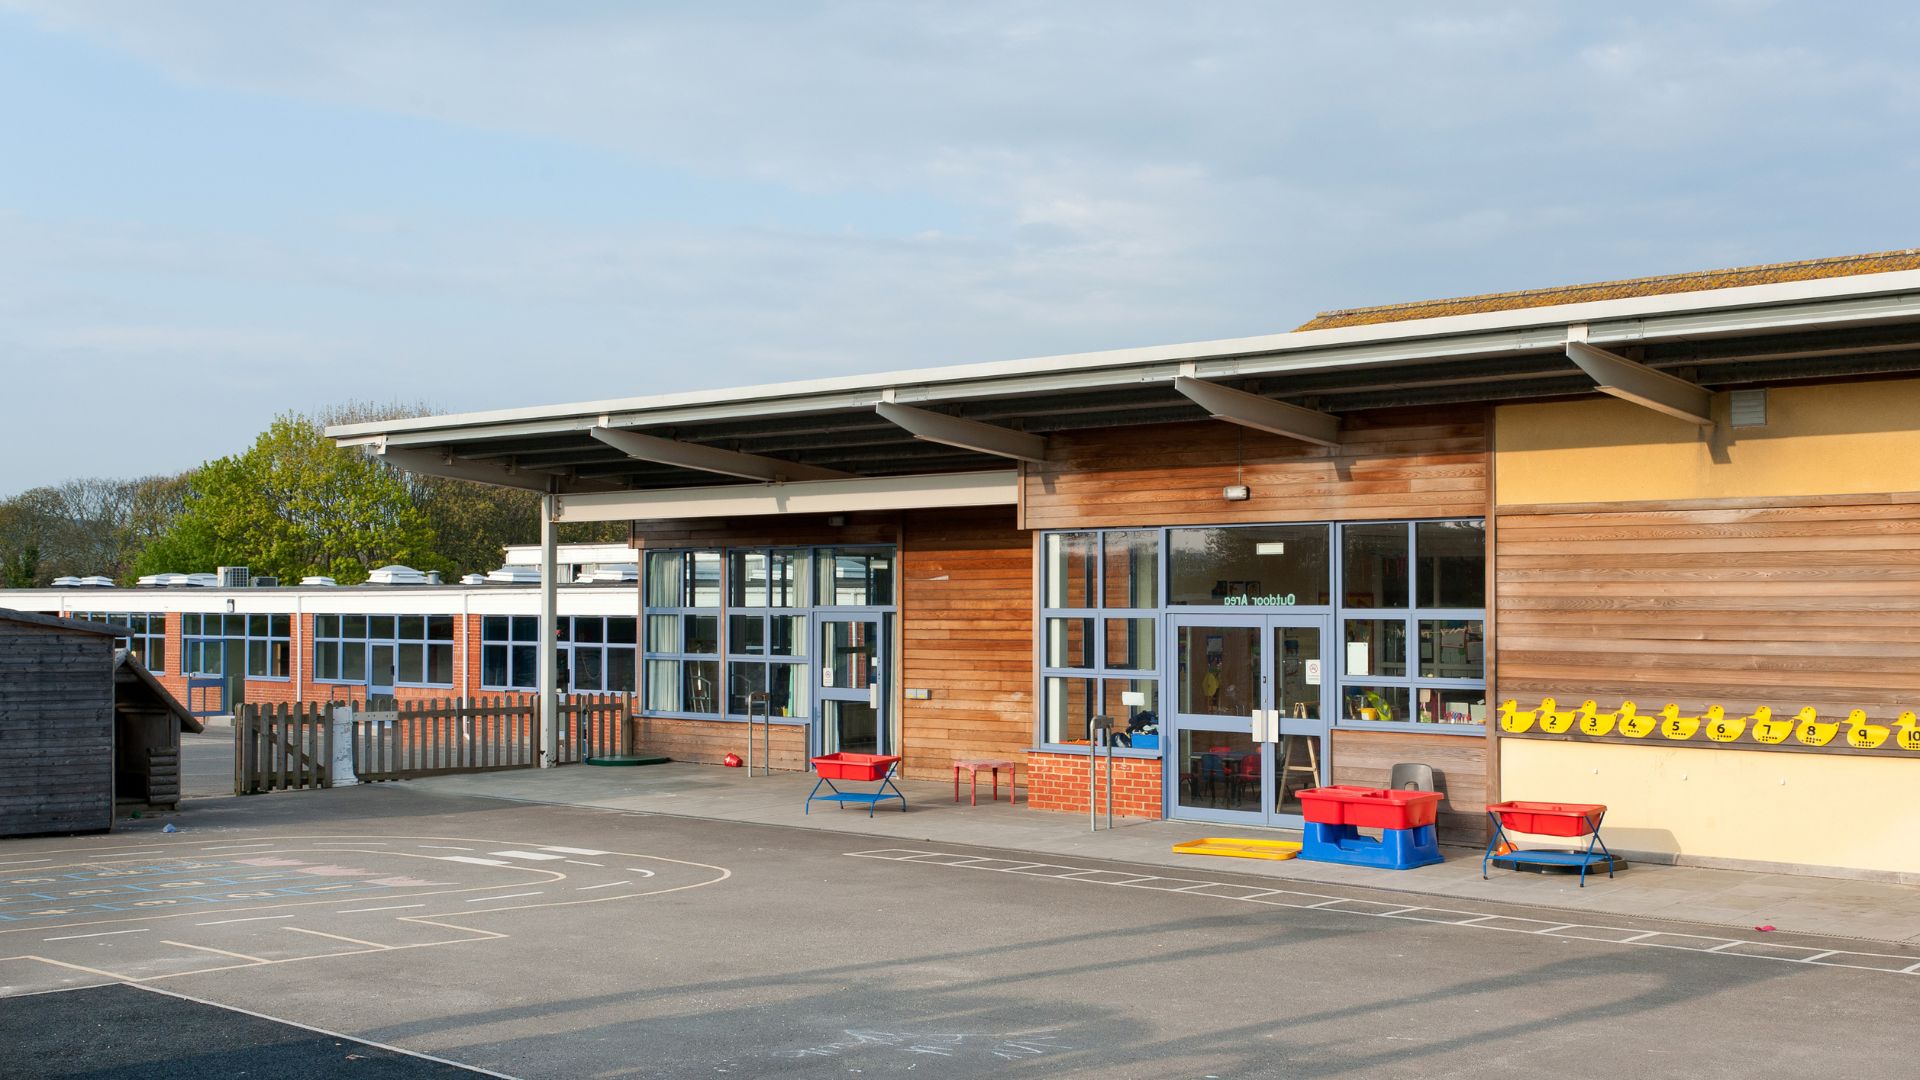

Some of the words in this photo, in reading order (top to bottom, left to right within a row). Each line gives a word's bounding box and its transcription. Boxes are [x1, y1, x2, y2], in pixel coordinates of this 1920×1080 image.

[1549, 715, 1557, 725] 2
[1589, 717, 1597, 727] 3
[1628, 718, 1636, 729] 4
[1672, 721, 1680, 731] 5
[1717, 723, 1725, 733] 6
[1763, 724, 1771, 735] 7
[1807, 725, 1816, 735] 8
[1858, 729, 1867, 740] 9
[1908, 730, 1920, 741] 10
